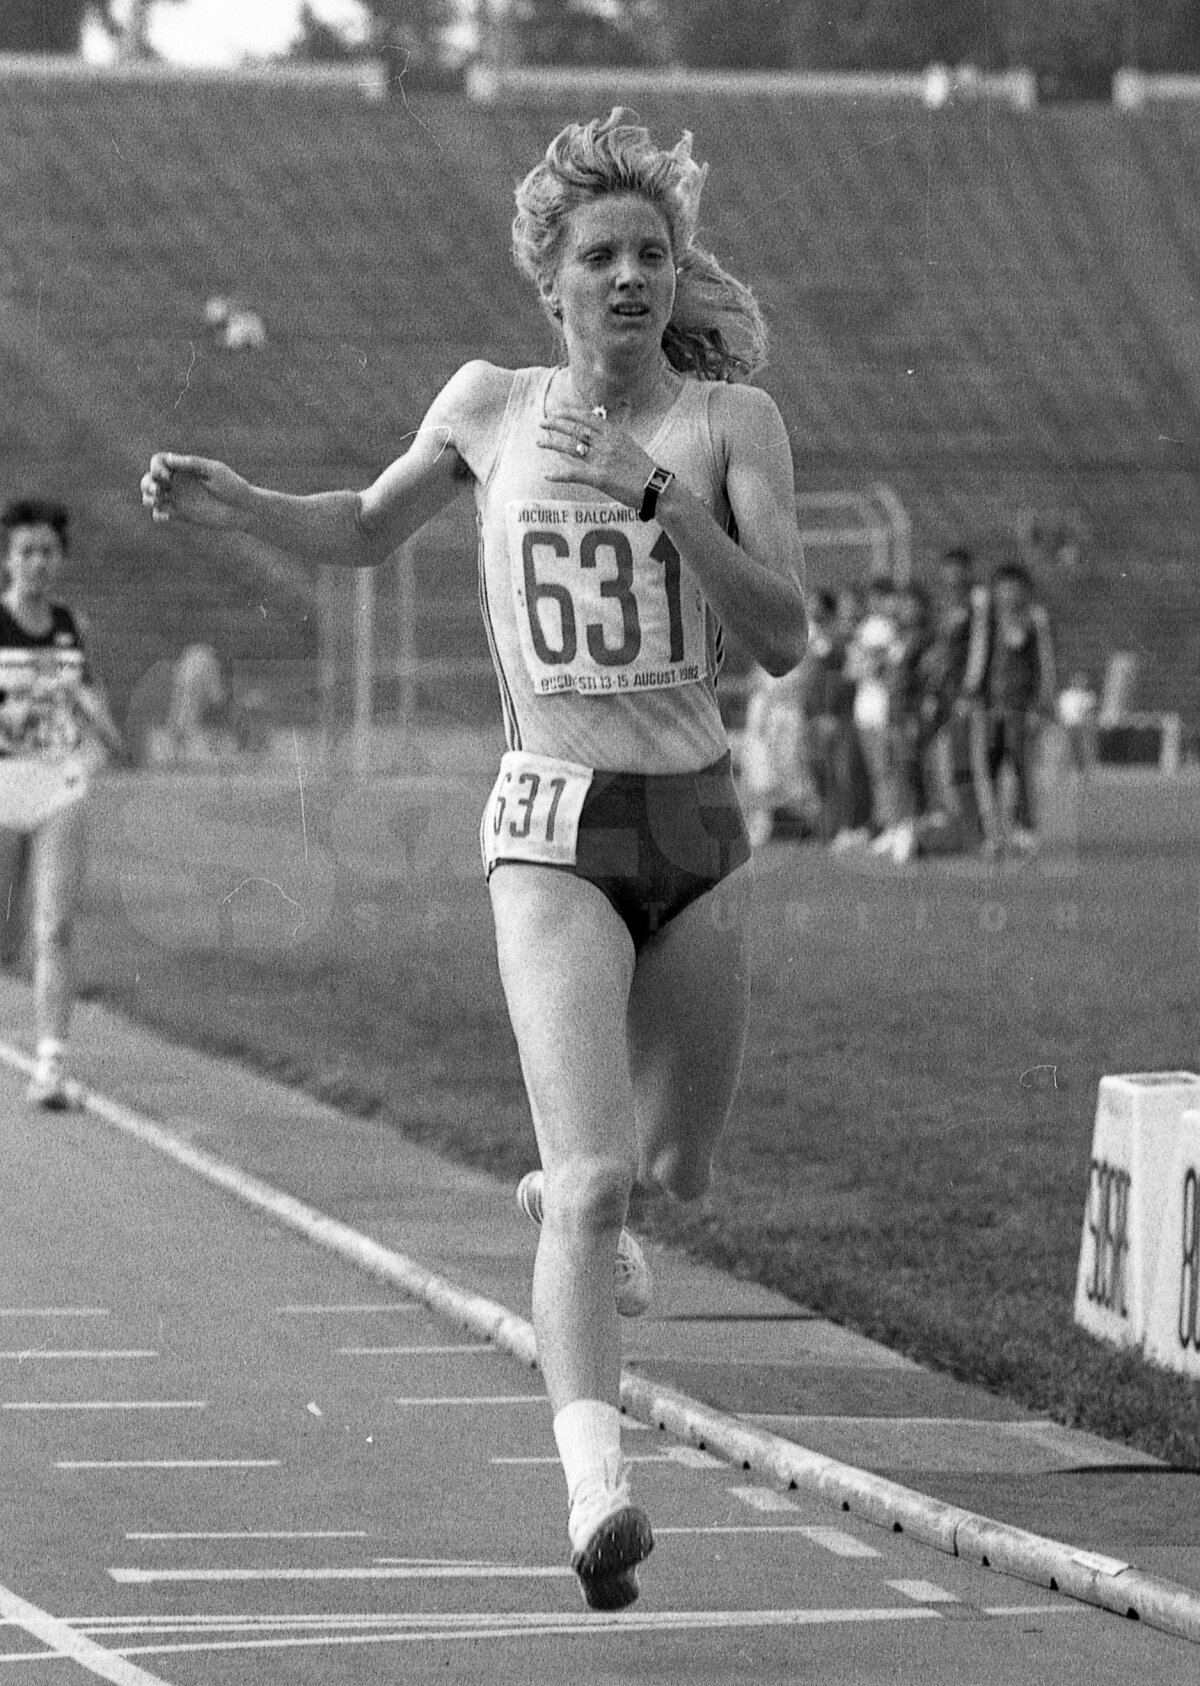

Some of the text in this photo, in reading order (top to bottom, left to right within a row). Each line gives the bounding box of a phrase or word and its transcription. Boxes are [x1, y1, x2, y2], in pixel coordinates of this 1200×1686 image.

[518, 509, 568, 524] JOCURILE
[522, 529, 684, 666] 631
[634, 669, 676, 688] AUGUST
